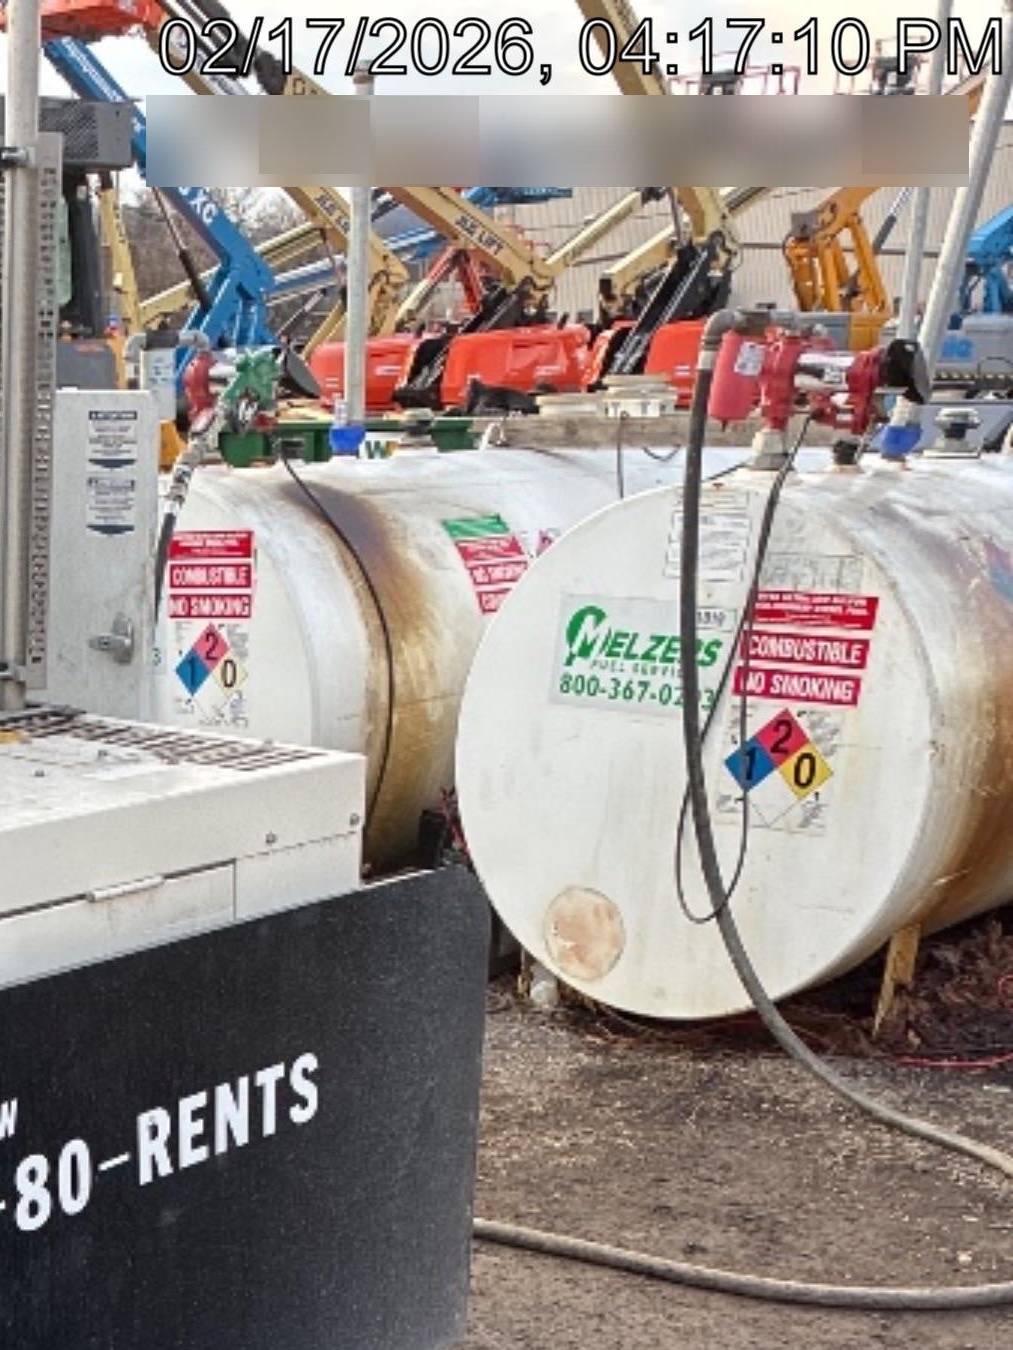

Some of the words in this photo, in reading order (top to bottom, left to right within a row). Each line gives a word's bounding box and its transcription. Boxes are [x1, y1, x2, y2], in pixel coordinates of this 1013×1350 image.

[171, 565, 249, 586] COMBUSTIBLE
[169, 596, 188, 616] NO
[190, 595, 250, 616] SMOKING
[205, 633, 219, 661] 2
[749, 635, 863, 665] COMBUSTIBLE
[221, 659, 237, 688] 0
[740, 670, 766, 695] NO
[770, 673, 855, 702] SMOKING
[770, 719, 793, 753] 2
[745, 746, 757, 780] 1
[794, 752, 816, 788] 0
